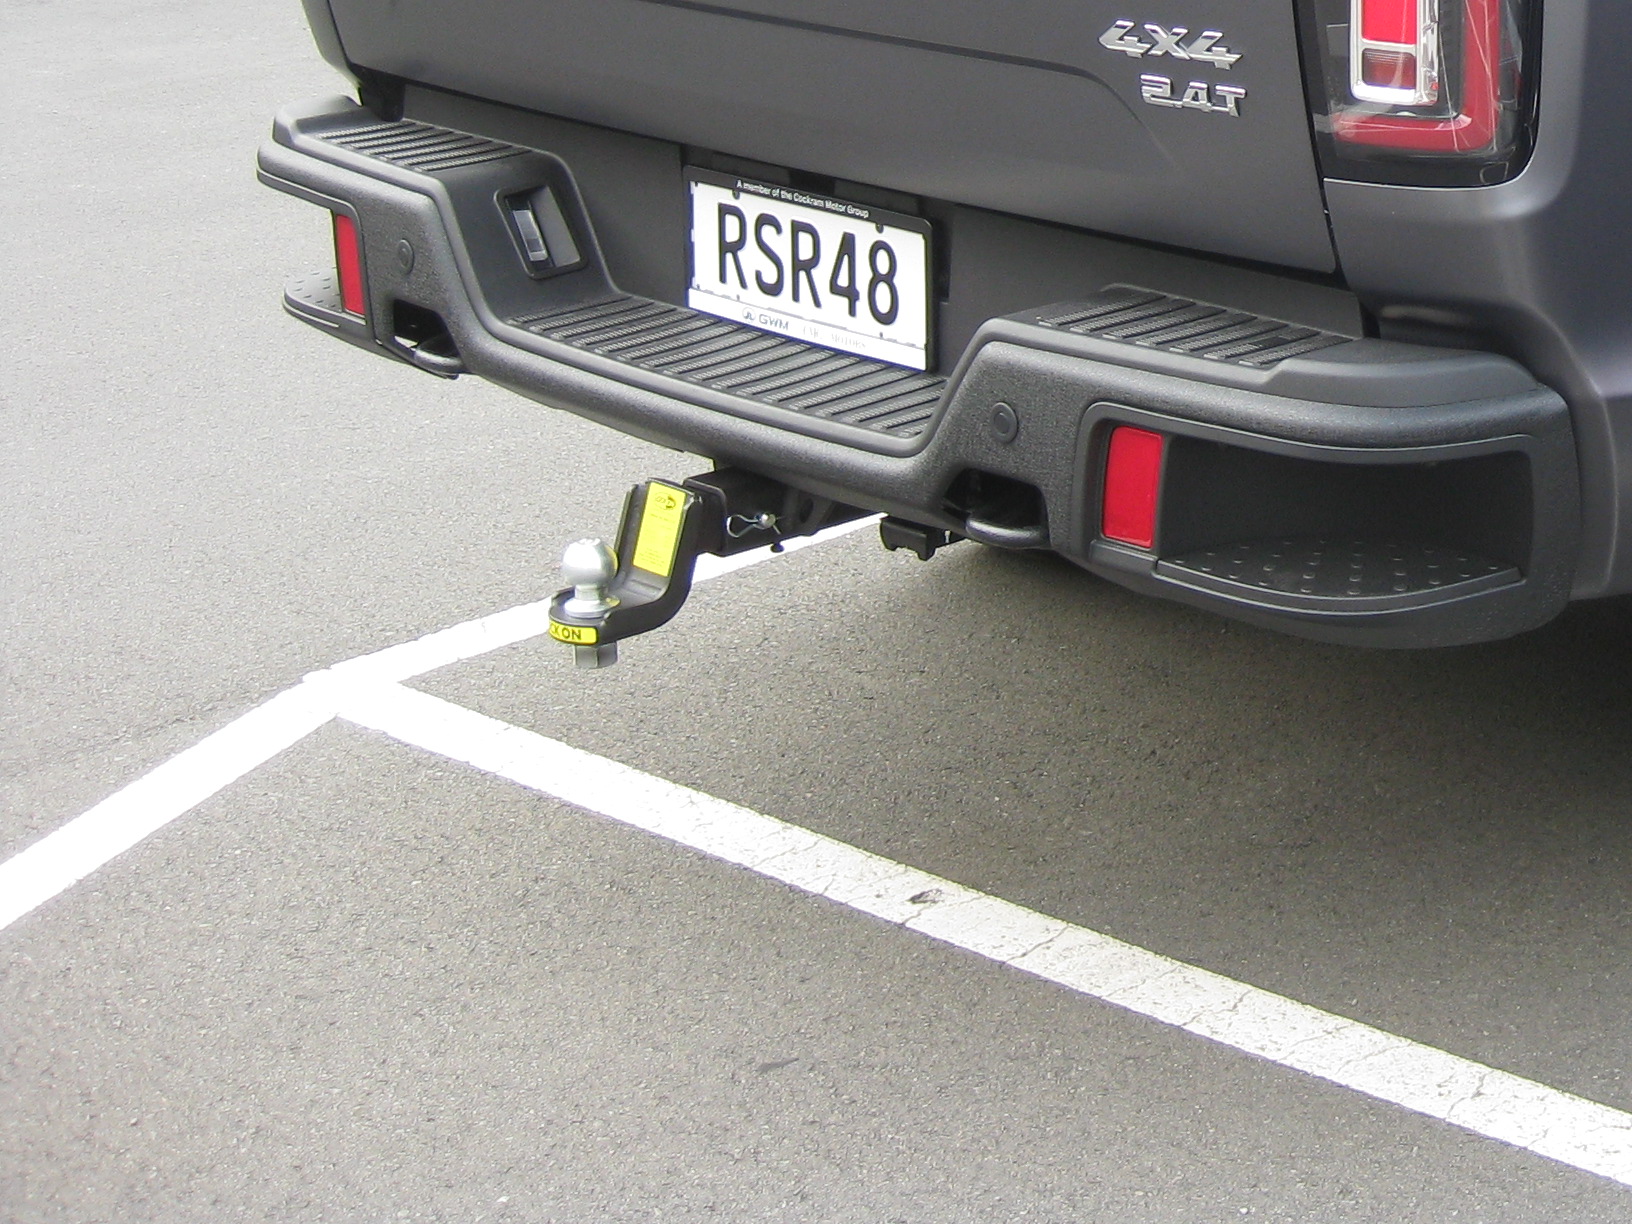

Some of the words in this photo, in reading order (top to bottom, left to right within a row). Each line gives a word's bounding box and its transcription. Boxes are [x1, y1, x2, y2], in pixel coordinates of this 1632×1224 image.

[743, 182, 771, 196] member
[771, 187, 780, 197] of
[780, 189, 793, 201] the
[825, 199, 847, 213] Motor
[846, 204, 870, 219] Group
[717, 202, 900, 326] RSR48
[758, 313, 789, 331] GWM
